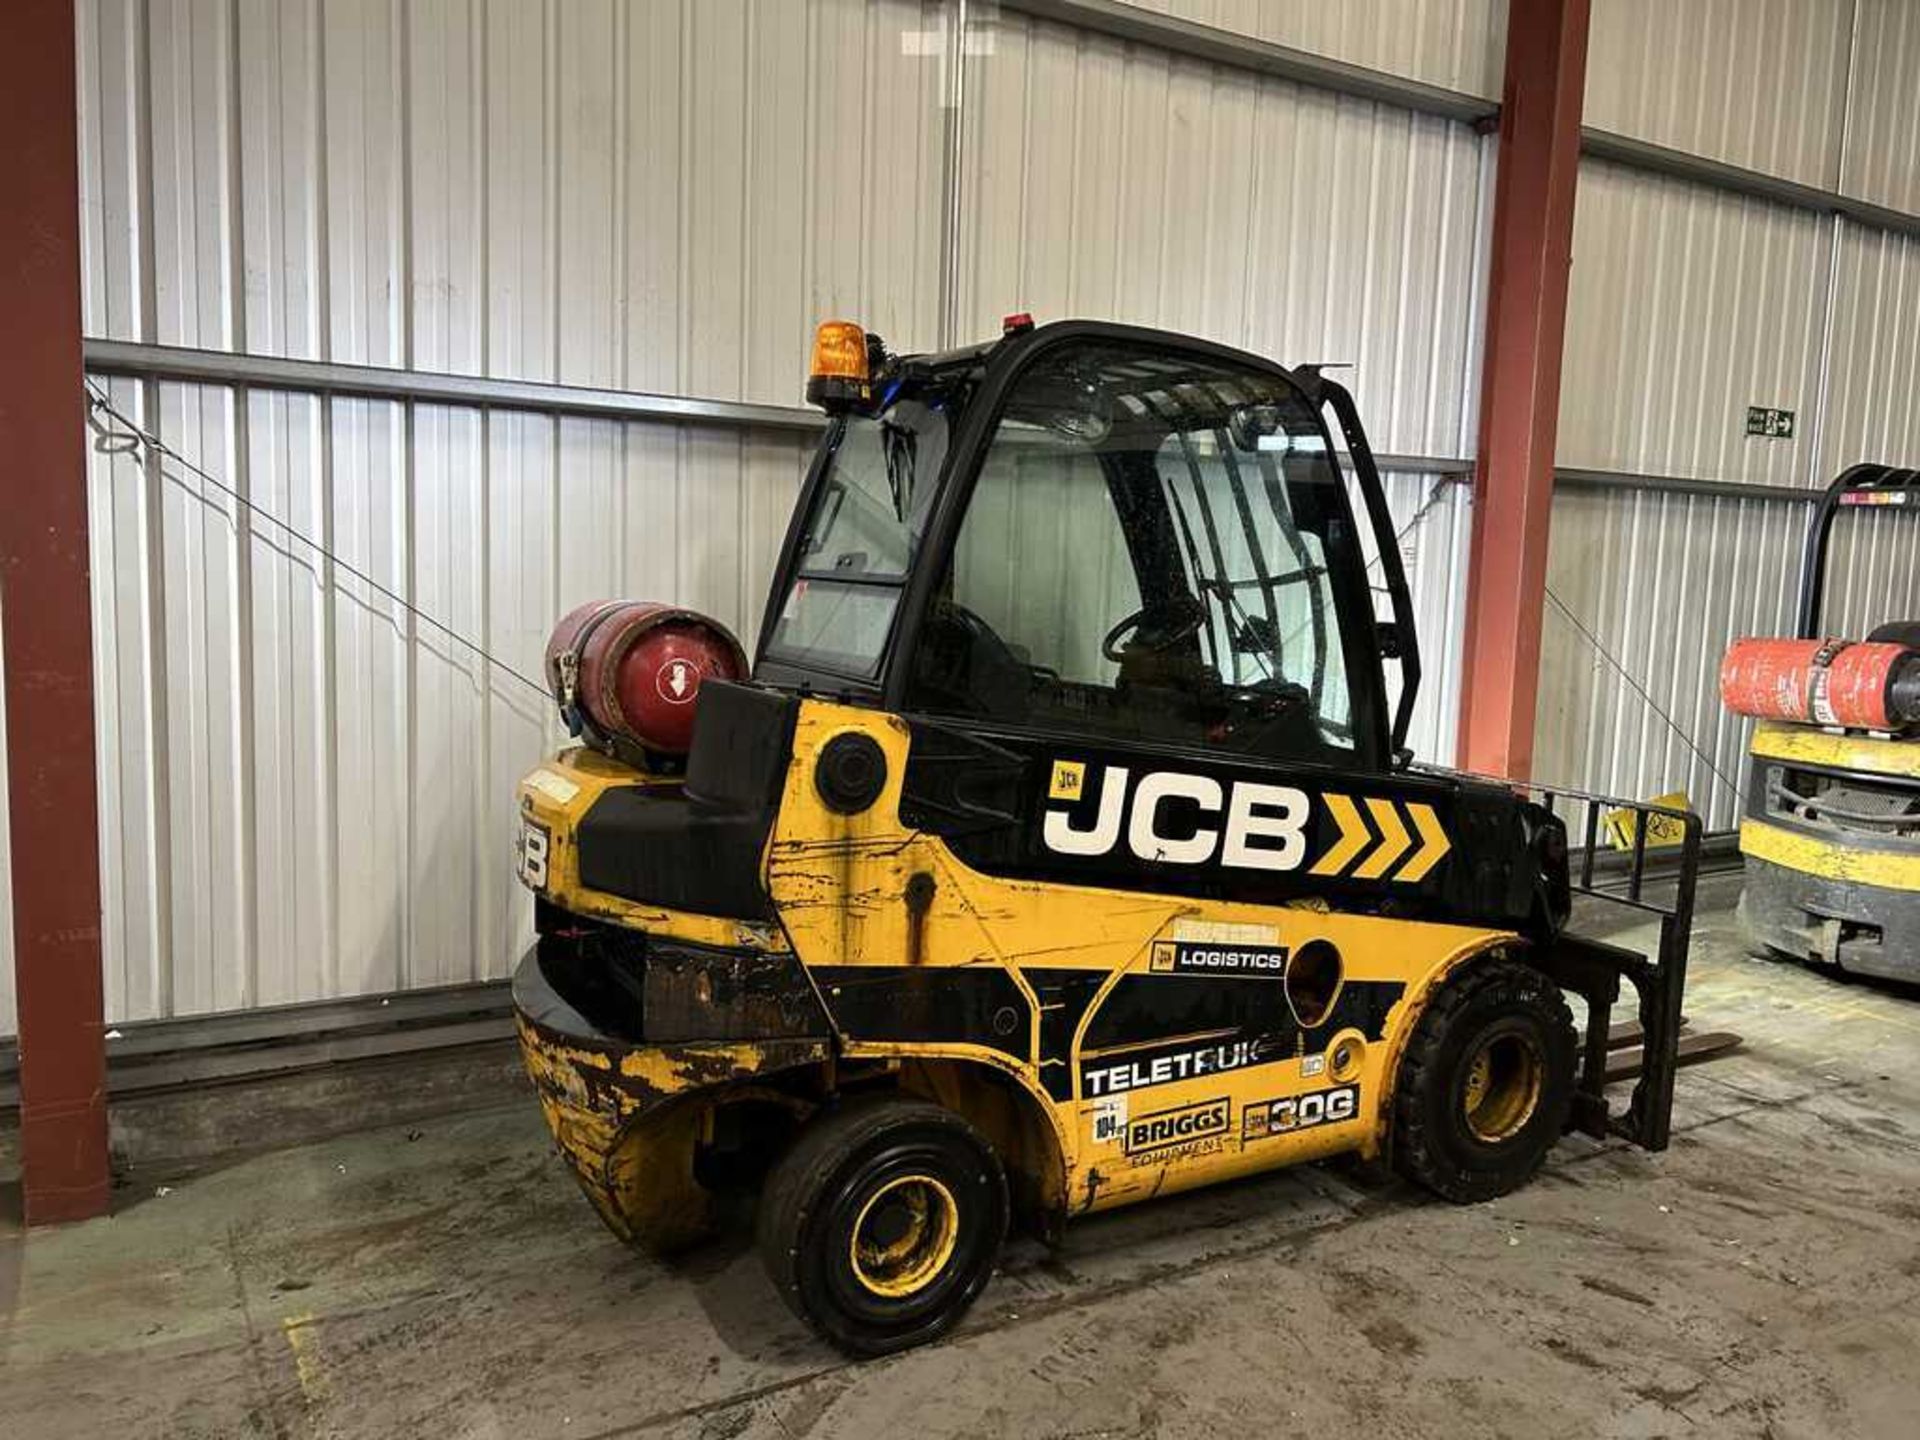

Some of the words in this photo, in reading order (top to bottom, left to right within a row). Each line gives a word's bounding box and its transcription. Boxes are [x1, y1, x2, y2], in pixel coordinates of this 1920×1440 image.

[1043, 766, 1310, 871] JCB
[1180, 950, 1282, 969] LOGISTICS
[1132, 1106, 1225, 1146] BRIGGS
[1271, 1087, 1355, 1132] 30G
